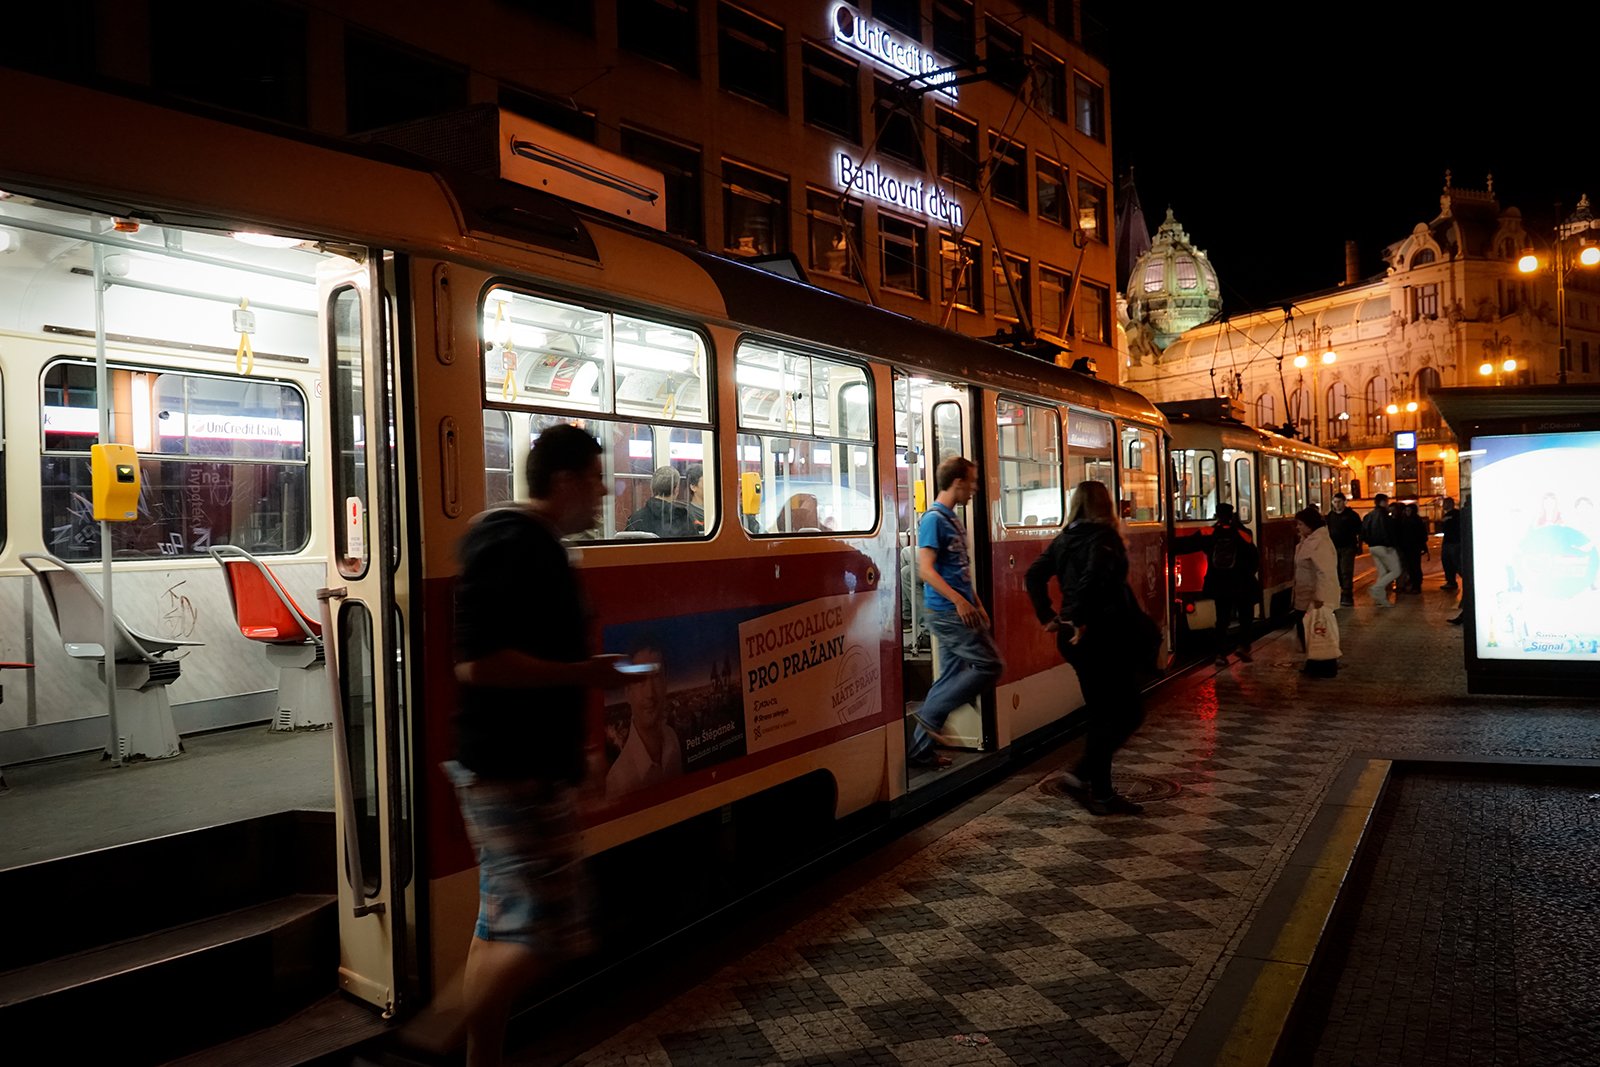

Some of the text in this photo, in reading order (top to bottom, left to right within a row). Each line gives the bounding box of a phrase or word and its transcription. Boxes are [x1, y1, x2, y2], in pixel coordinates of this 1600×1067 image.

[854, 16, 921, 76] UniCredit
[837, 152, 963, 227] Bankovní dům
[207, 421, 282, 437] UniCredit Bank
[746, 606, 842, 658] TROJKOALICE
[1531, 641, 1564, 652] Signal
[748, 635, 844, 693] PRO PRAŽANY
[831, 684, 854, 709] MÁTE
[855, 668, 879, 693] PRÁVO
[686, 720, 735, 750] Petr Štěpánek
